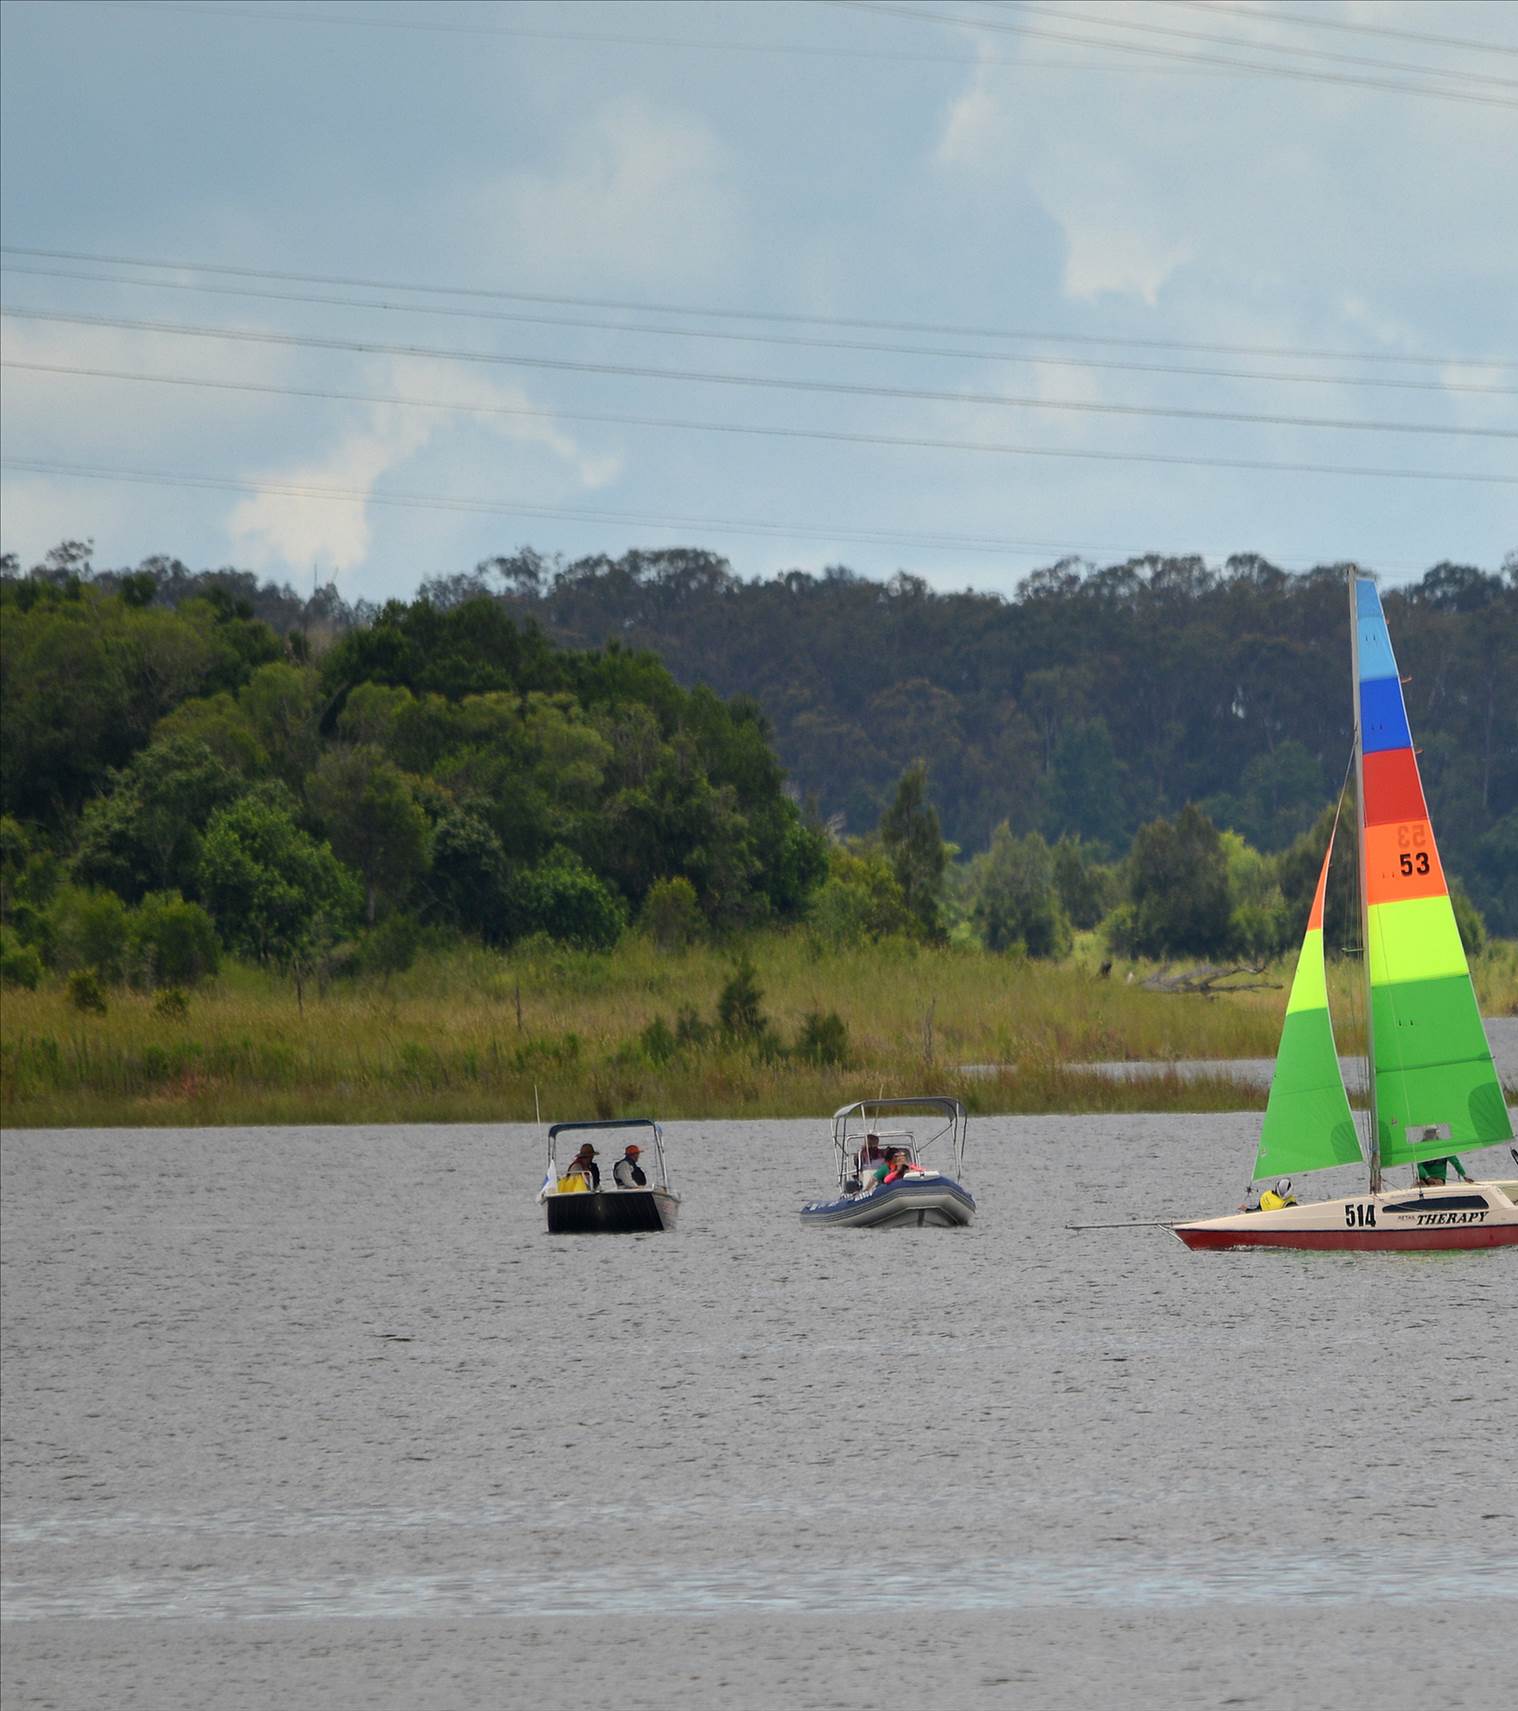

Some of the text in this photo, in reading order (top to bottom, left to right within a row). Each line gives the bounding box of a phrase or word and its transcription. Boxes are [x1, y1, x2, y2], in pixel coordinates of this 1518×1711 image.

[1399, 852, 1430, 876] 53
[1345, 1204, 1376, 1227] 514
[1416, 1211, 1489, 1225] THERAPY
